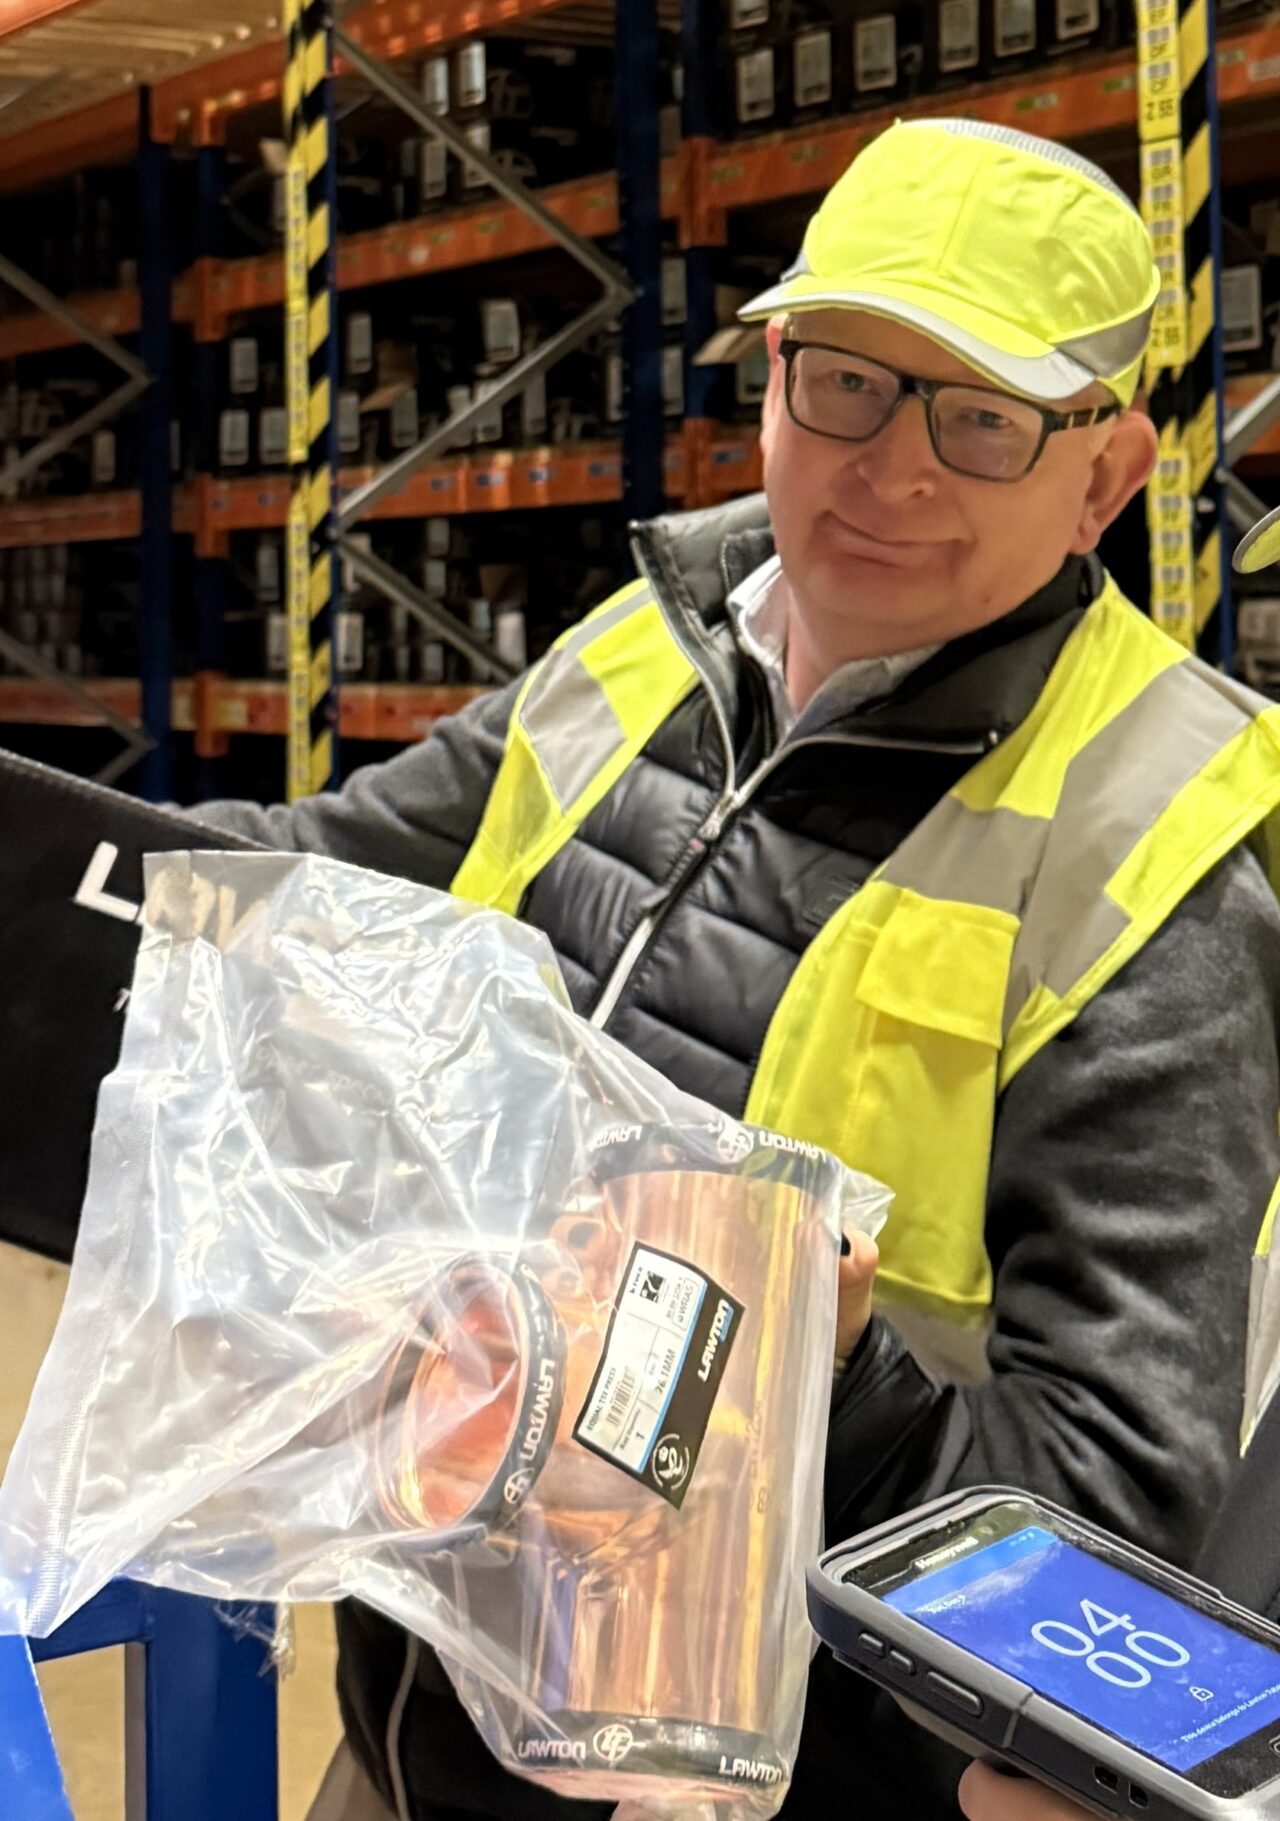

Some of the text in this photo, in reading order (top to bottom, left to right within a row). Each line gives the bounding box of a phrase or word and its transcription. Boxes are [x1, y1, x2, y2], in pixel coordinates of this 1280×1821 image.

[697, 1298, 729, 1382] LAWTON
[519, 1359, 555, 1461] LAWTON
[1030, 1598, 1137, 1657] 04
[1085, 1630, 1191, 1689] 00
[517, 1739, 586, 1760] LAWTON
